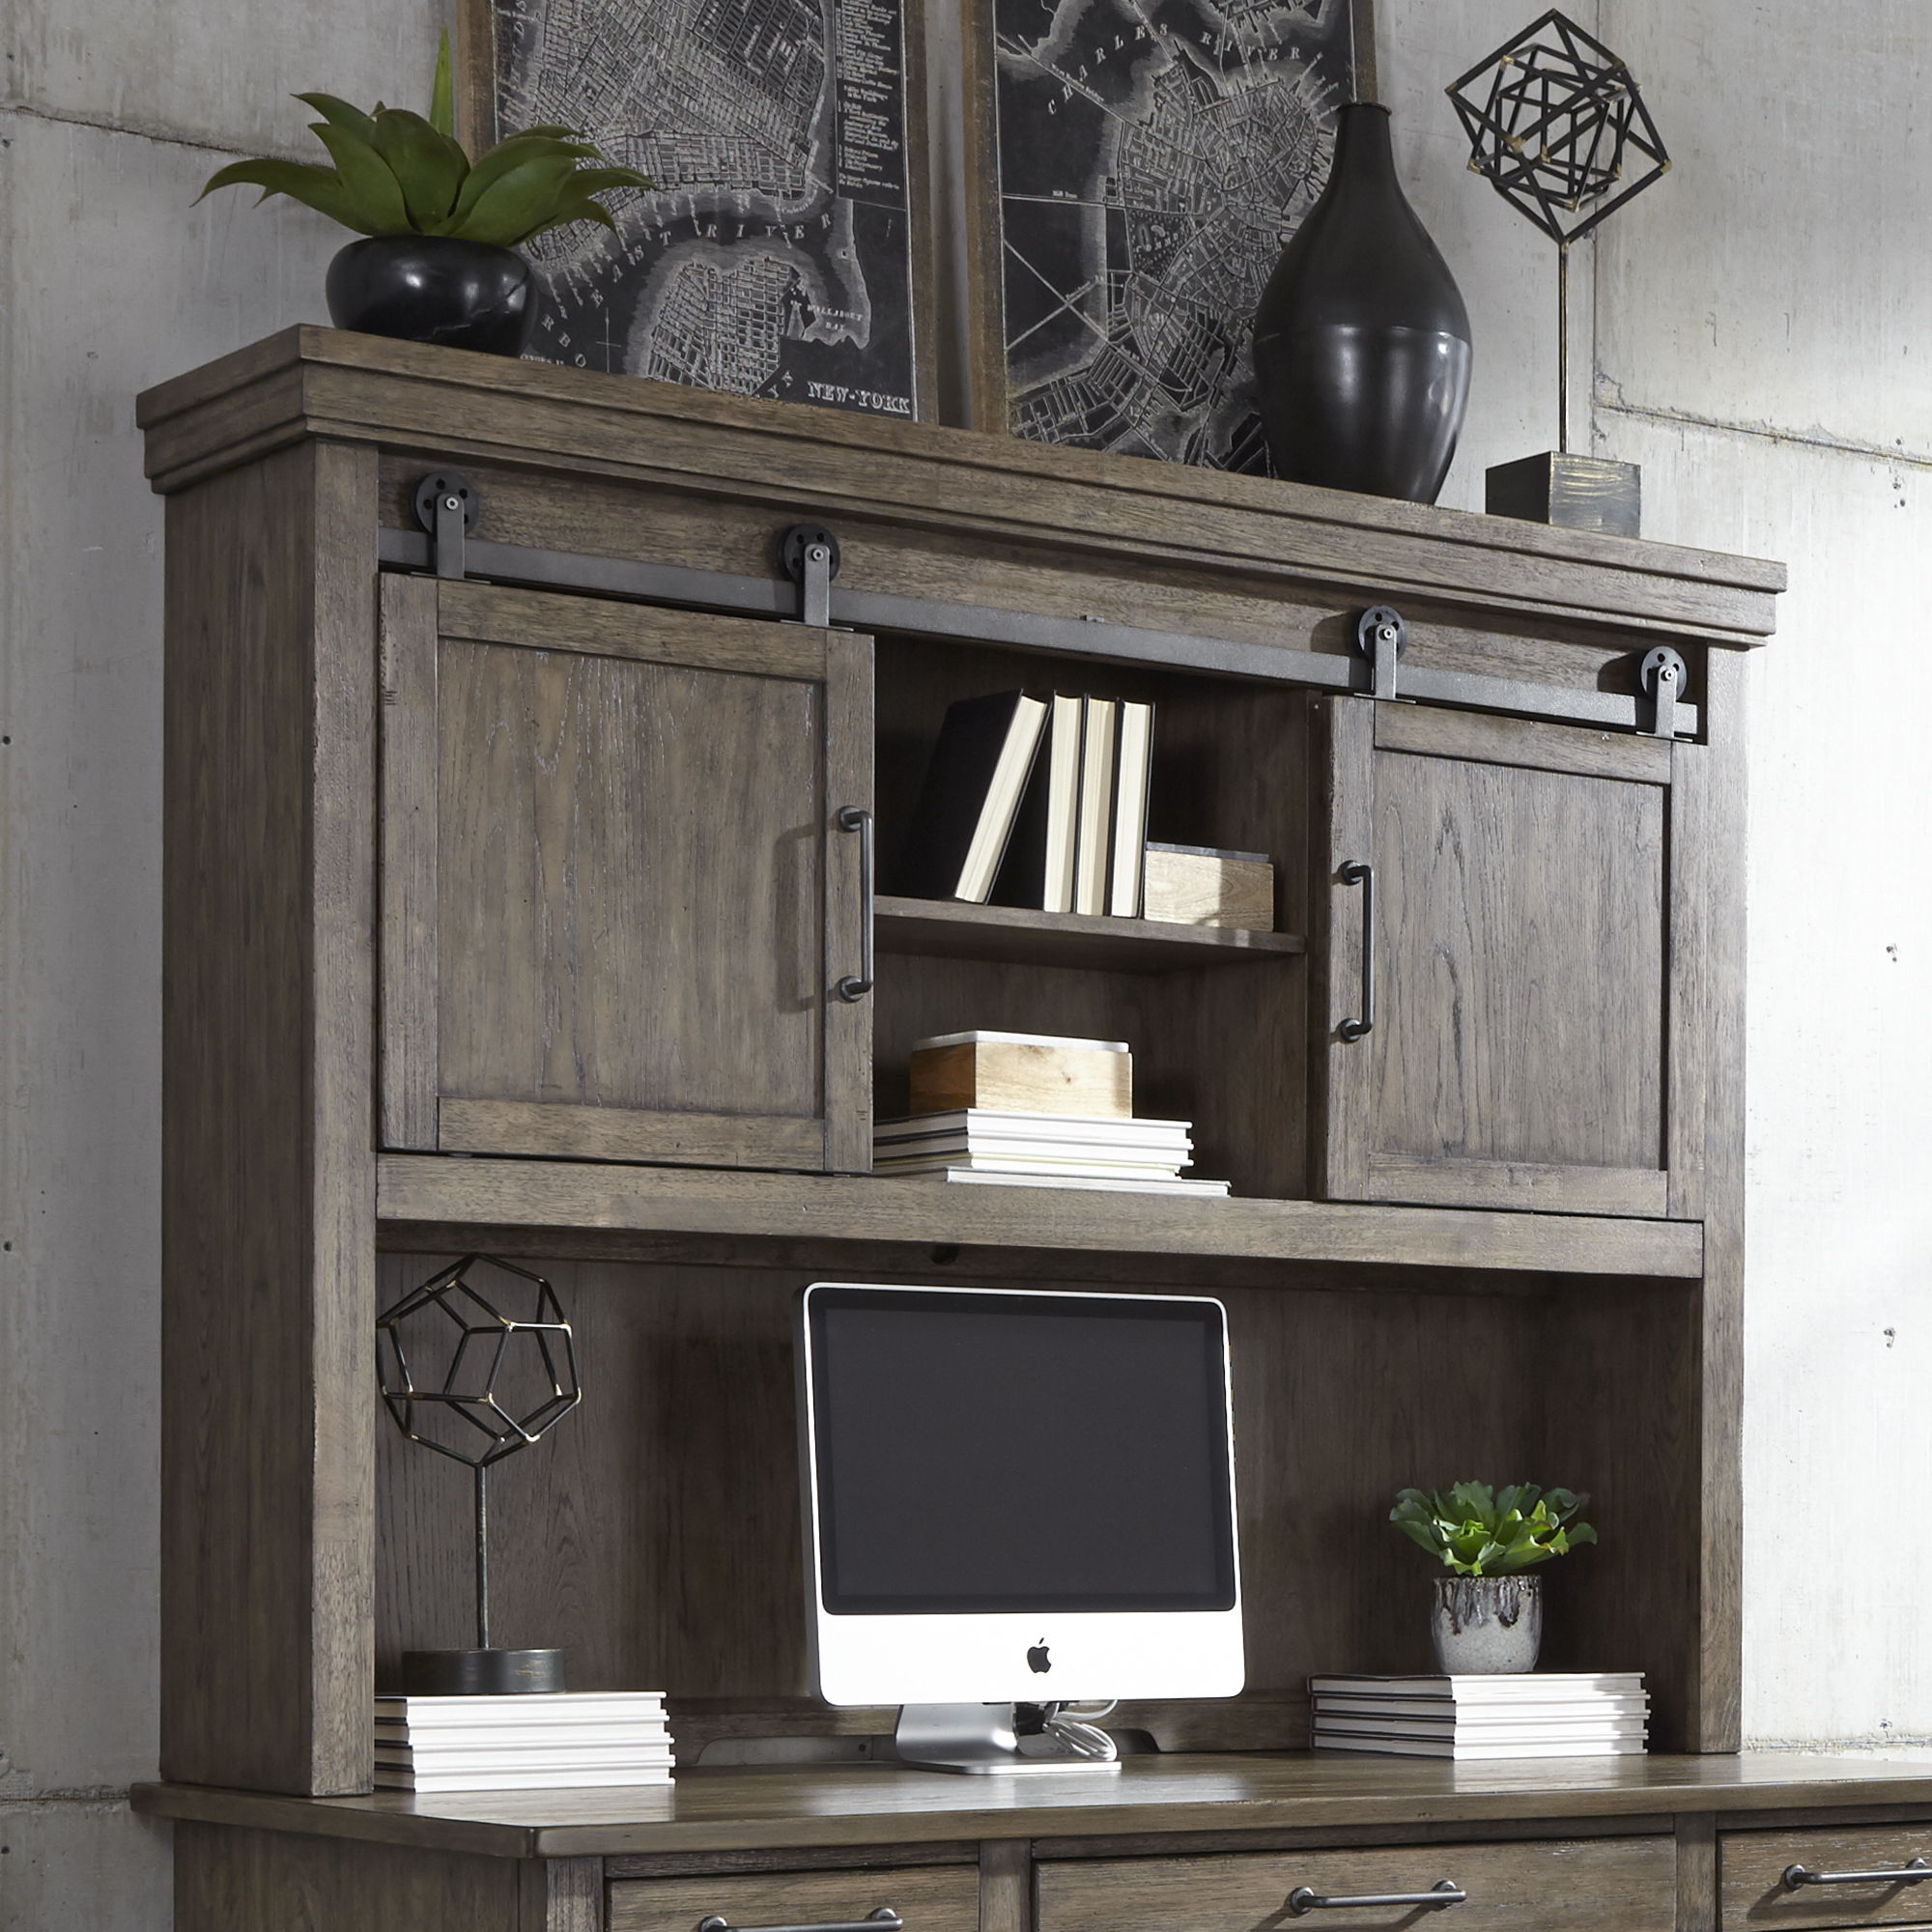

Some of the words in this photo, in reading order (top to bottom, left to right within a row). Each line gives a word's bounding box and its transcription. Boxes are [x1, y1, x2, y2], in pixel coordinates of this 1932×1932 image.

[591, 230, 671, 309] EAST
[706, 213, 833, 241] RIVER
[808, 381, 911, 414] NEW-YORK
